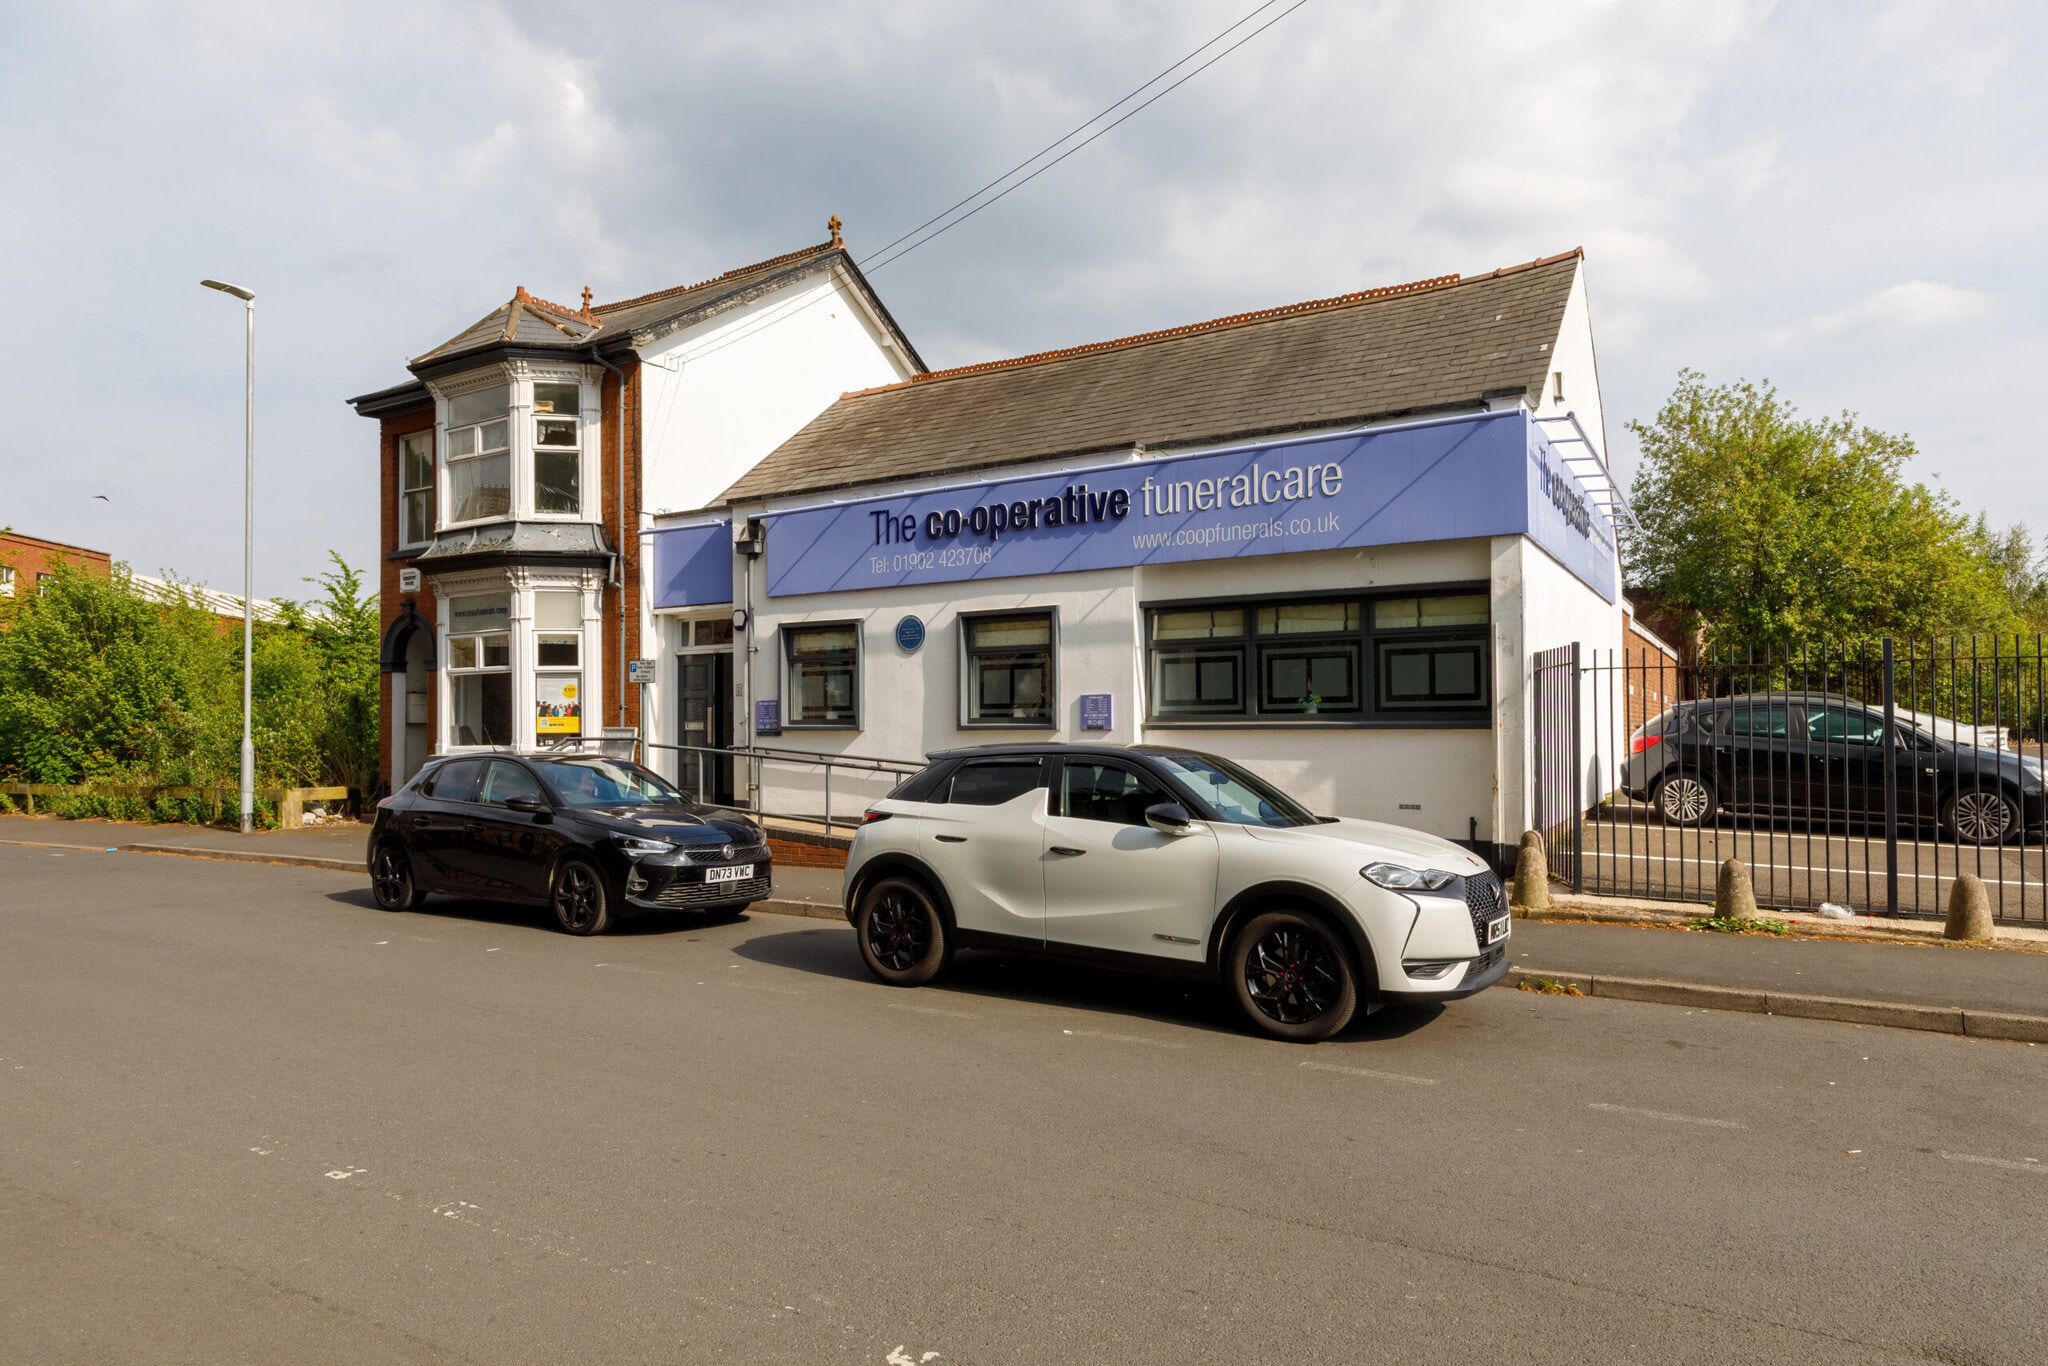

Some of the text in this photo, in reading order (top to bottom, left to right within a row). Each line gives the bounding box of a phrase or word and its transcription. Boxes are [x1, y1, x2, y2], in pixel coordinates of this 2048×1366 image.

[869, 508, 917, 546] The
[1140, 461, 1343, 517] funeralcare
[1132, 511, 1340, 550] www.coopfunerals.co.uk
[869, 546, 992, 574] Tel: 01902 423708
[710, 868, 732, 880] DN73
